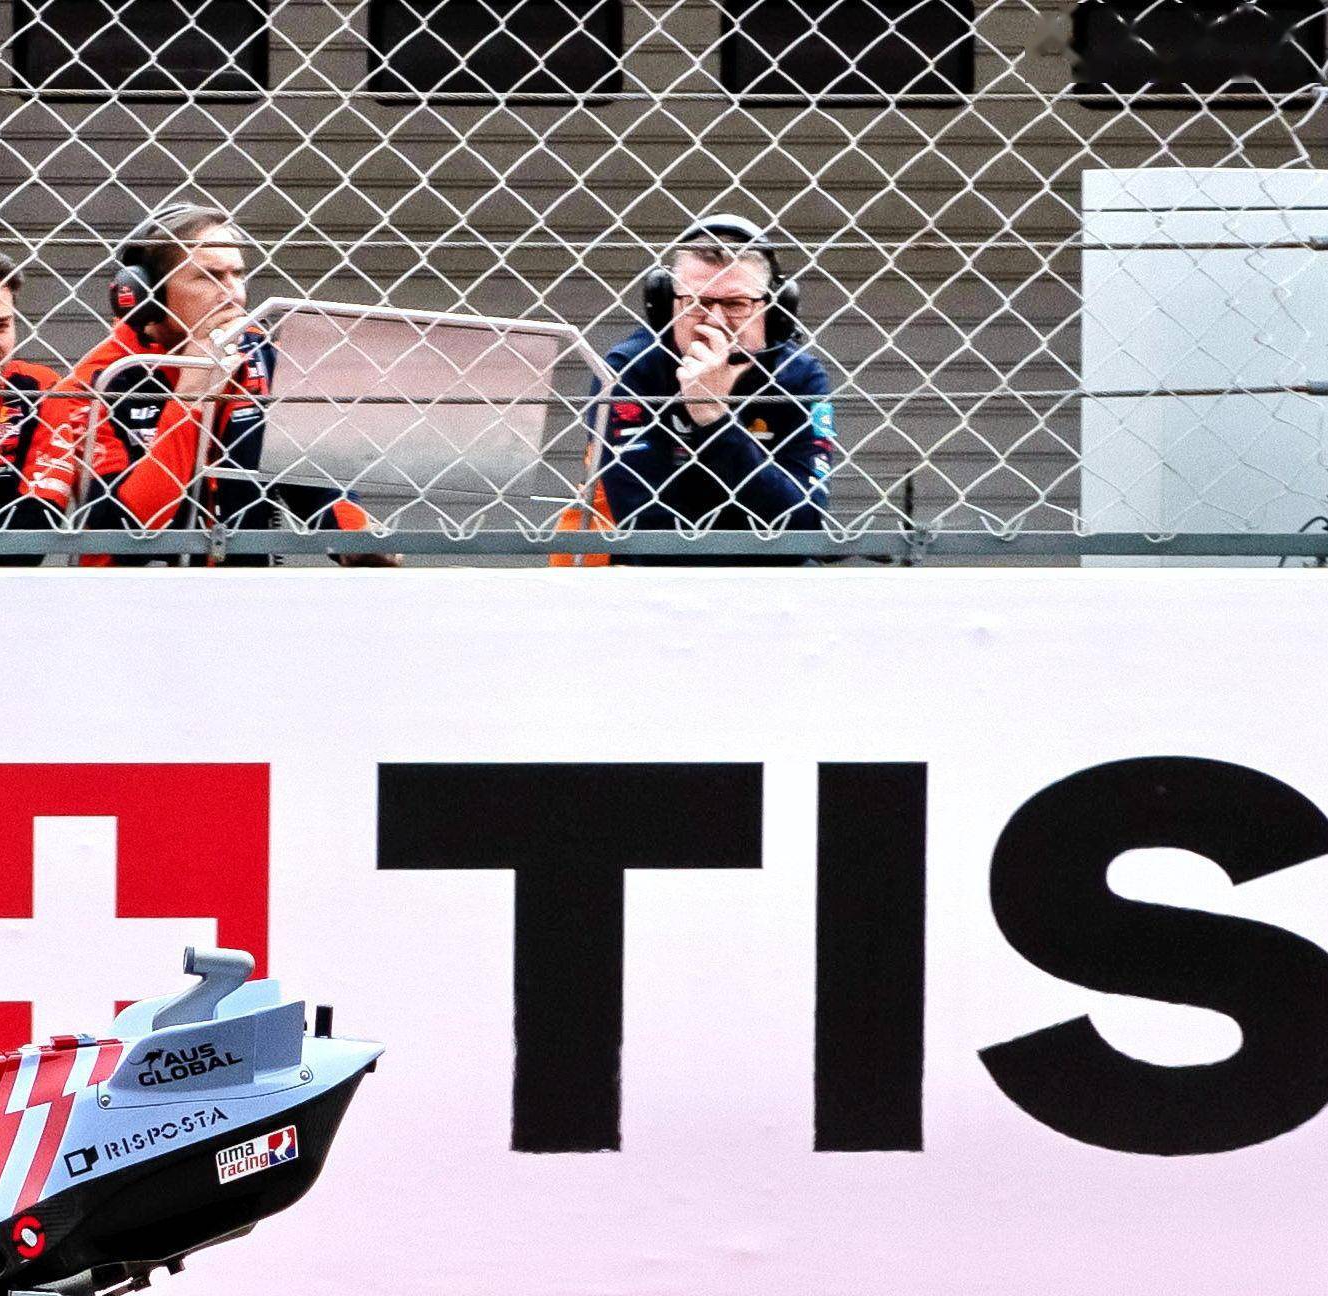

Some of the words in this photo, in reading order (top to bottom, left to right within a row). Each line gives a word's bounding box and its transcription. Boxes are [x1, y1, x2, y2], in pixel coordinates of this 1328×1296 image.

[164, 1043, 216, 1067] AUS
[138, 1052, 243, 1087] GLOBAL
[217, 1142, 254, 1166] uma
[220, 1152, 269, 1179] racing
